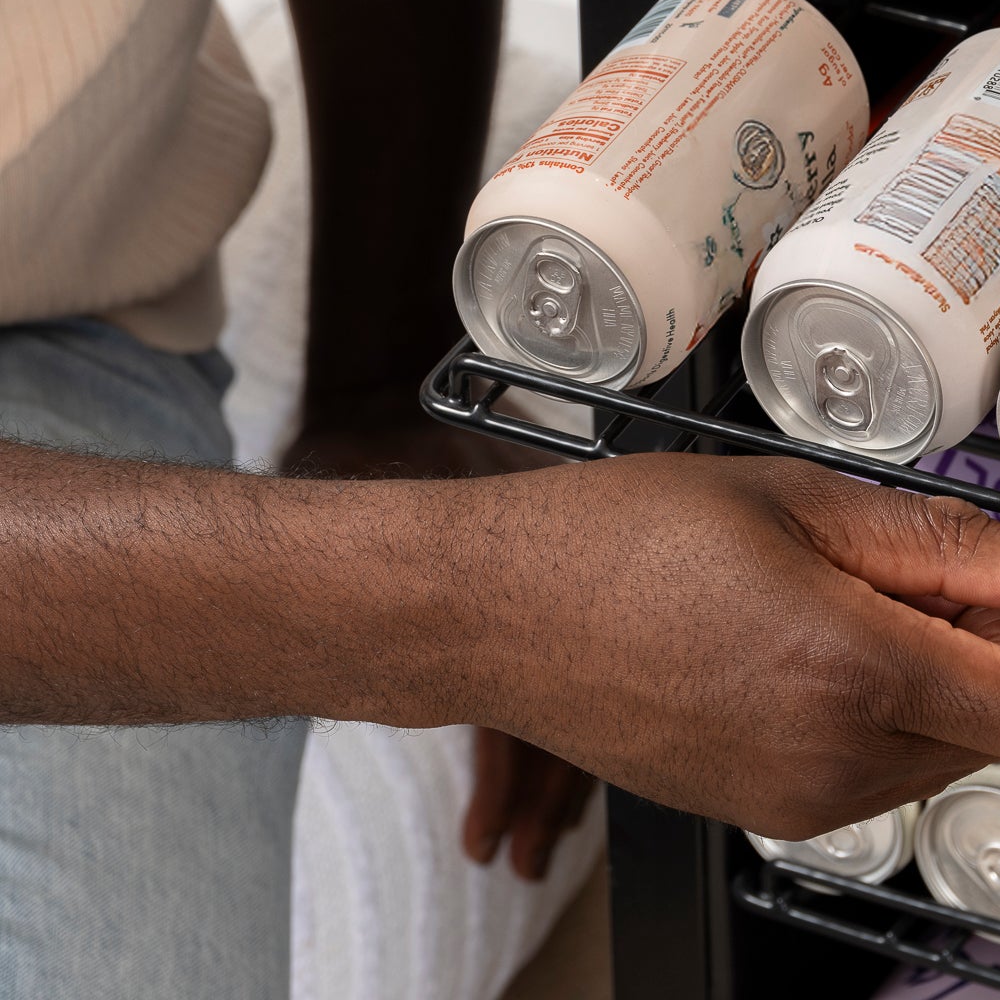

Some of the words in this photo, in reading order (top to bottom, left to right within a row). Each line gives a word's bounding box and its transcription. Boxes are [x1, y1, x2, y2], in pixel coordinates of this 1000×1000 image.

[827, 42, 841, 61] can
[716, 54, 731, 69] Juice
[821, 47, 841, 75] sugar
[818, 62, 833, 87] 4g
[840, 63, 853, 80] per
[837, 76, 847, 87] of
[558, 118, 621, 132] Calories
[662, 111, 677, 127] Juice
[651, 124, 678, 153] Strawberry
[527, 148, 595, 163] Nutrition
[641, 149, 656, 164] Juice
[543, 159, 585, 175] Contains
[613, 160, 646, 195] Concentrate,
[634, 168, 652, 186] Fiber,
[621, 181, 640, 201] Nopal
[661, 306, 681, 336] Health
[652, 334, 674, 372] Digestive
[982, 334, 1000, 355] Nopal
